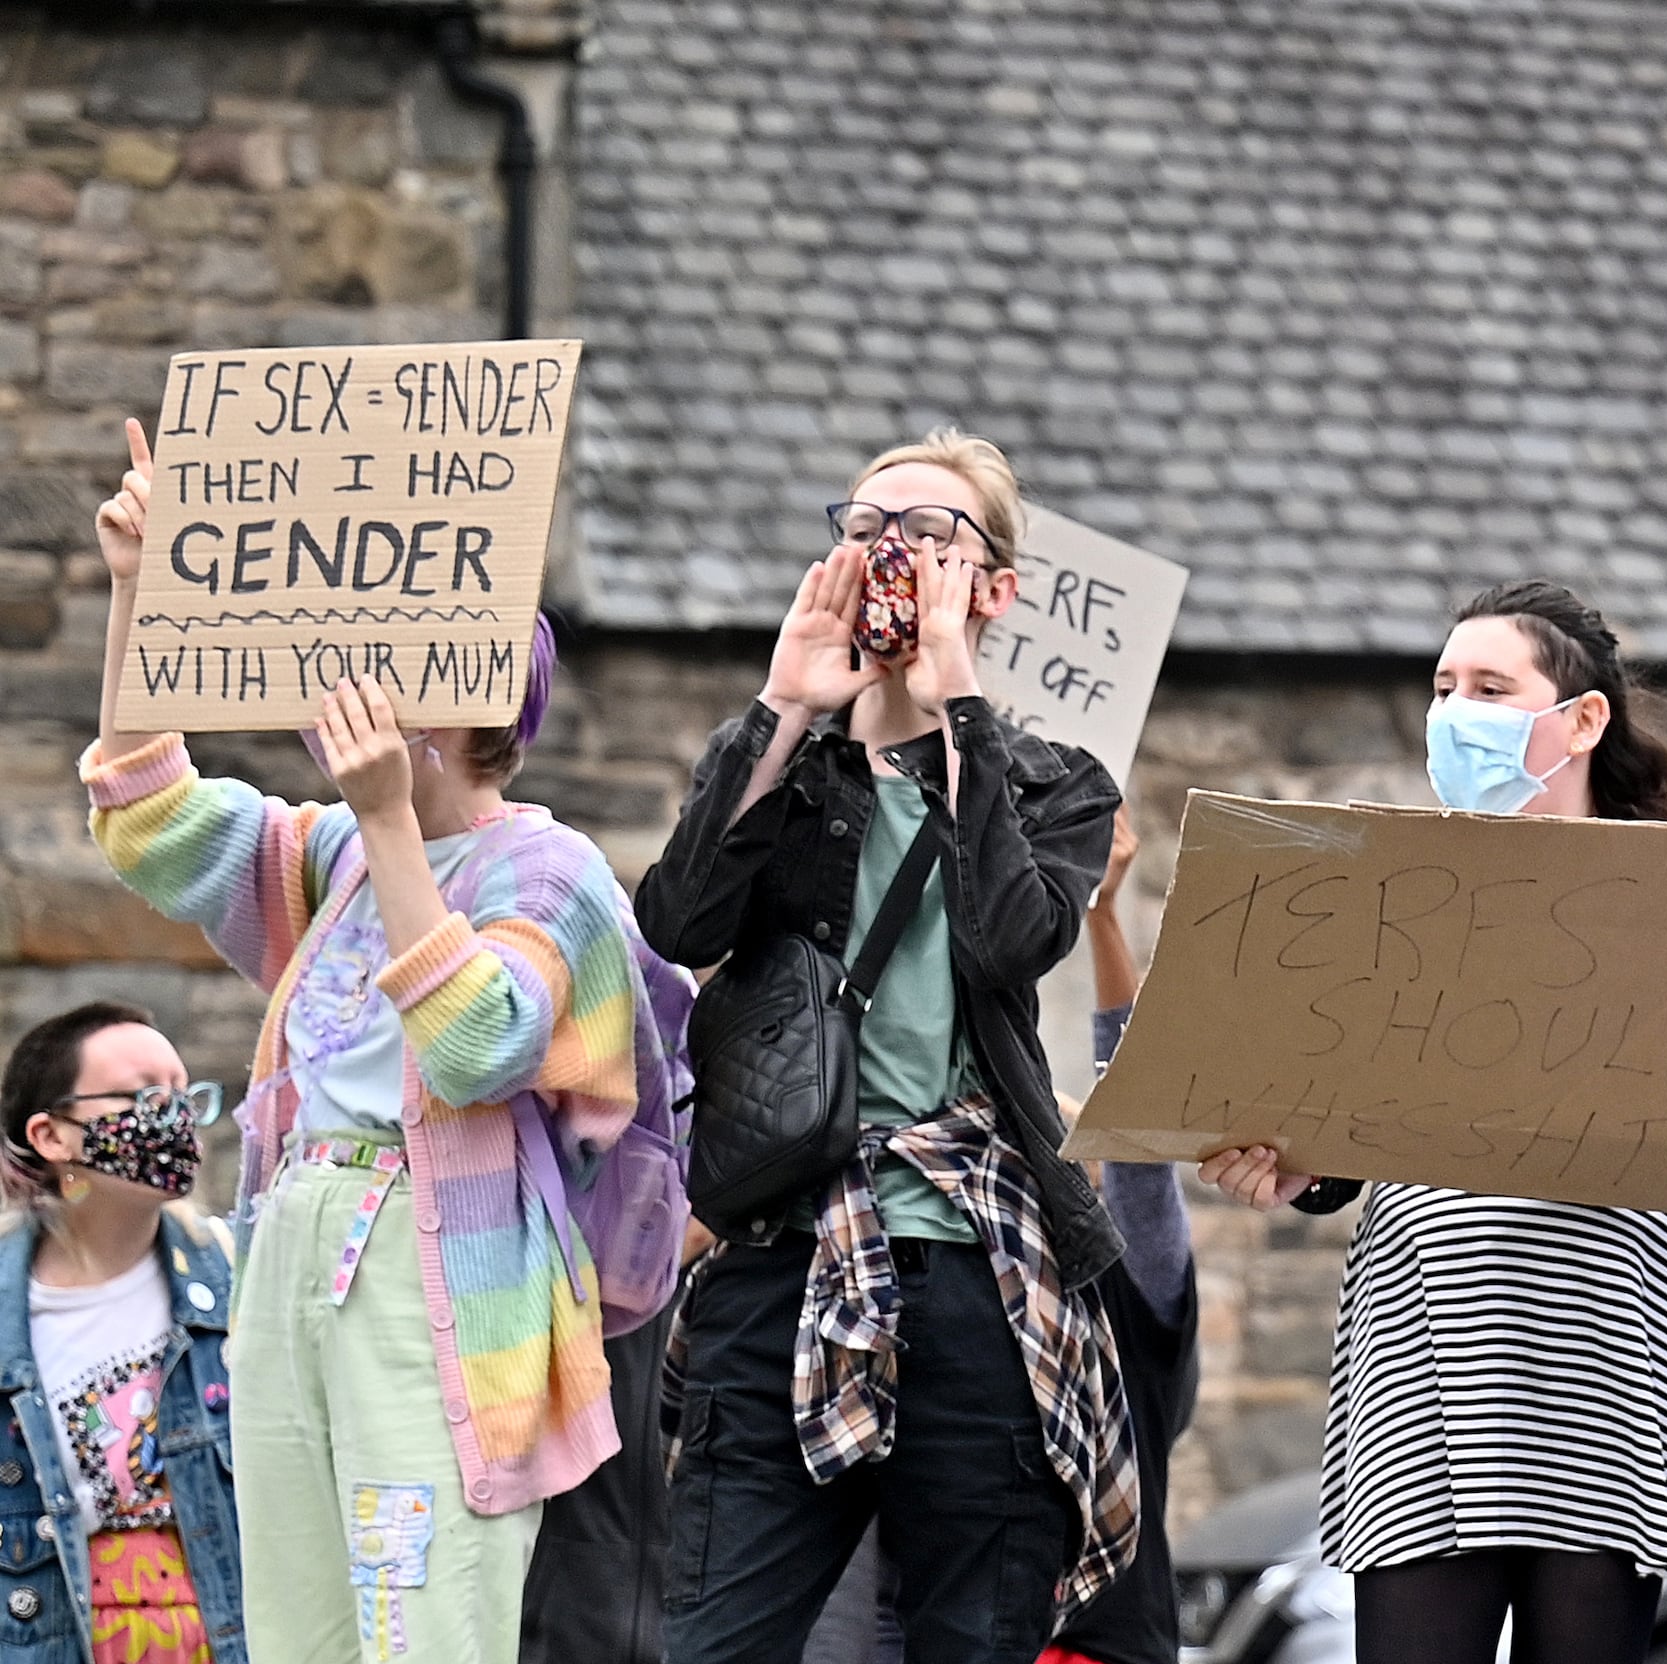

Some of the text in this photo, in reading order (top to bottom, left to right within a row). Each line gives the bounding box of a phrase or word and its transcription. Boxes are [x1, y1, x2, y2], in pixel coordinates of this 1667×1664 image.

[164, 360, 246, 437] IF
[255, 356, 352, 435] SEX
[394, 354, 561, 437] GENDER
[168, 451, 514, 504] THEN I HAD
[170, 516, 492, 597] GENDER
[1015, 553, 1127, 653] ERFs
[139, 638, 514, 706] WITH YOUR MUM
[976, 623, 1115, 713] ET OFF
[1194, 861, 1638, 990] TERFS
